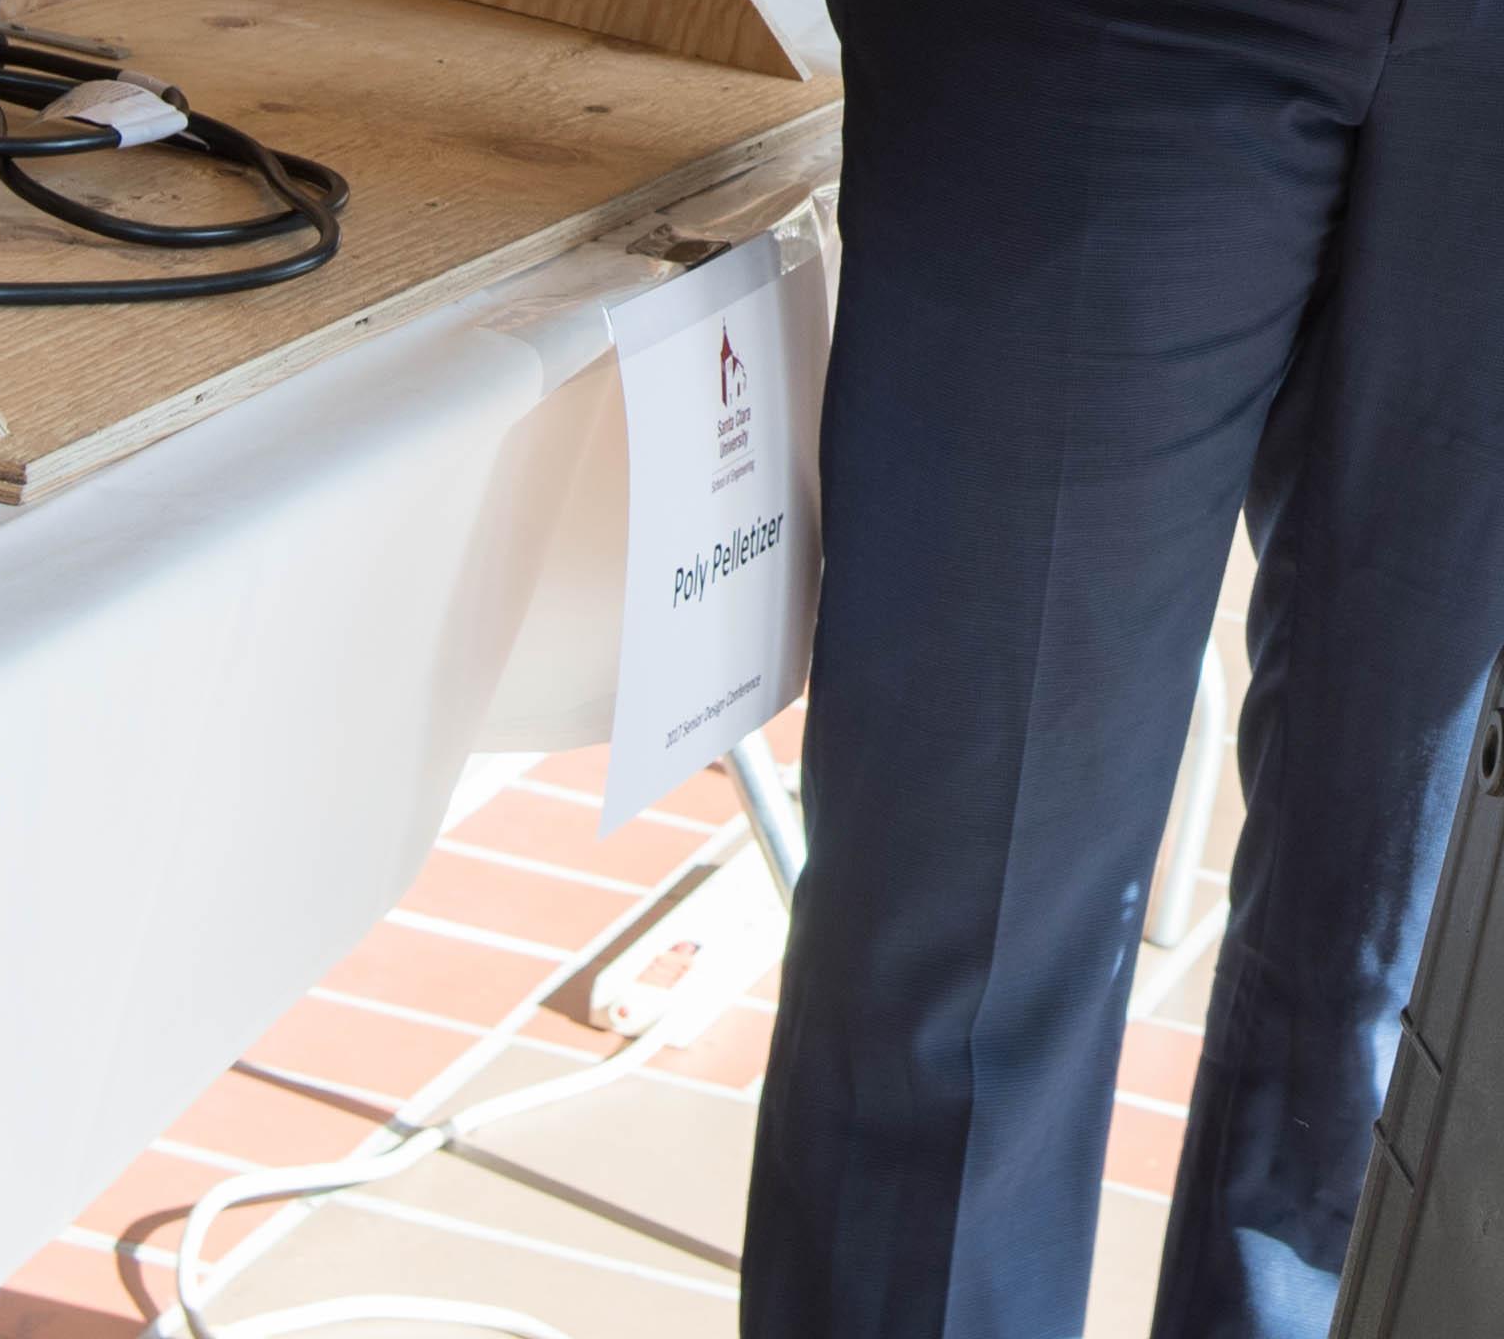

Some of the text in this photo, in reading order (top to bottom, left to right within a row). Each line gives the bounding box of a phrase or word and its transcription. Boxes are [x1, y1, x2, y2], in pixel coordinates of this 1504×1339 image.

[673, 512, 785, 609] Poly Pelletizer
[665, 674, 762, 749] 2017 Senior Design Conference
